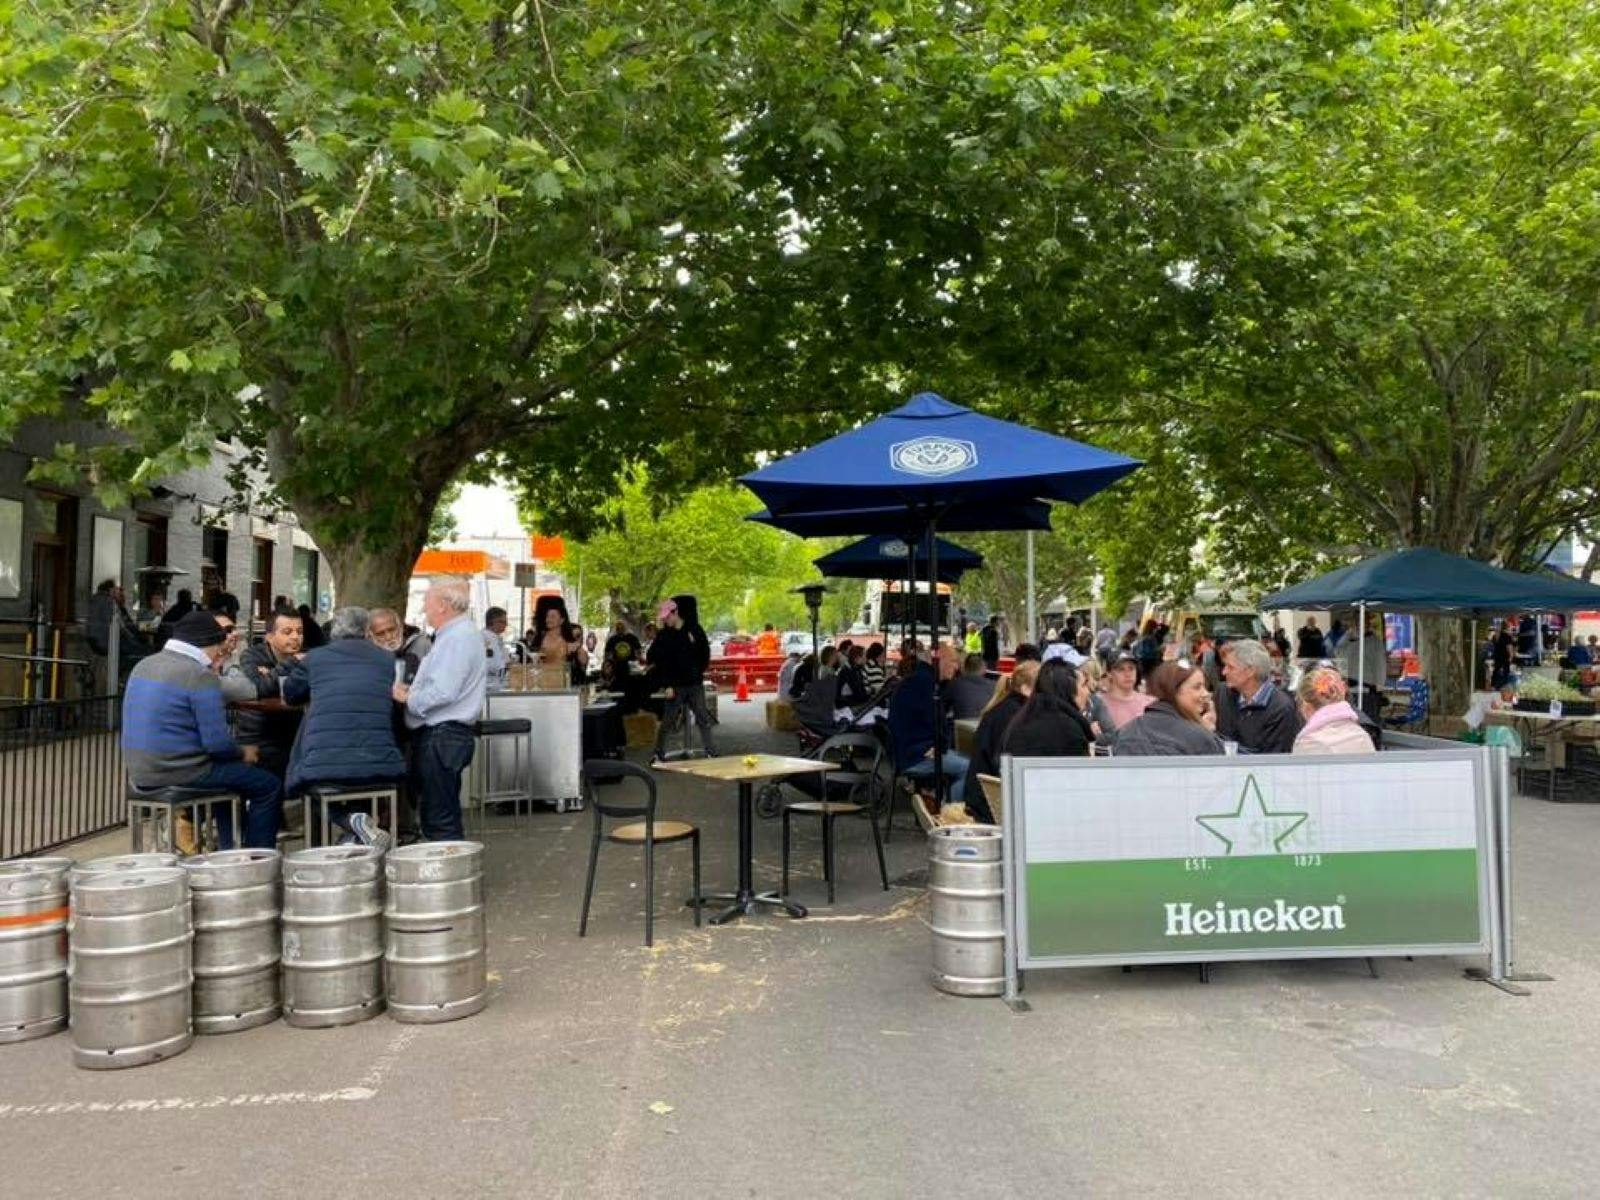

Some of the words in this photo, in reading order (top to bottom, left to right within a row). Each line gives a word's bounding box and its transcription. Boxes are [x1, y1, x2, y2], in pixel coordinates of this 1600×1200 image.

[1185, 858, 1212, 871] EST.
[1295, 855, 1321, 867] 1873
[1164, 899, 1346, 936] Heineken
